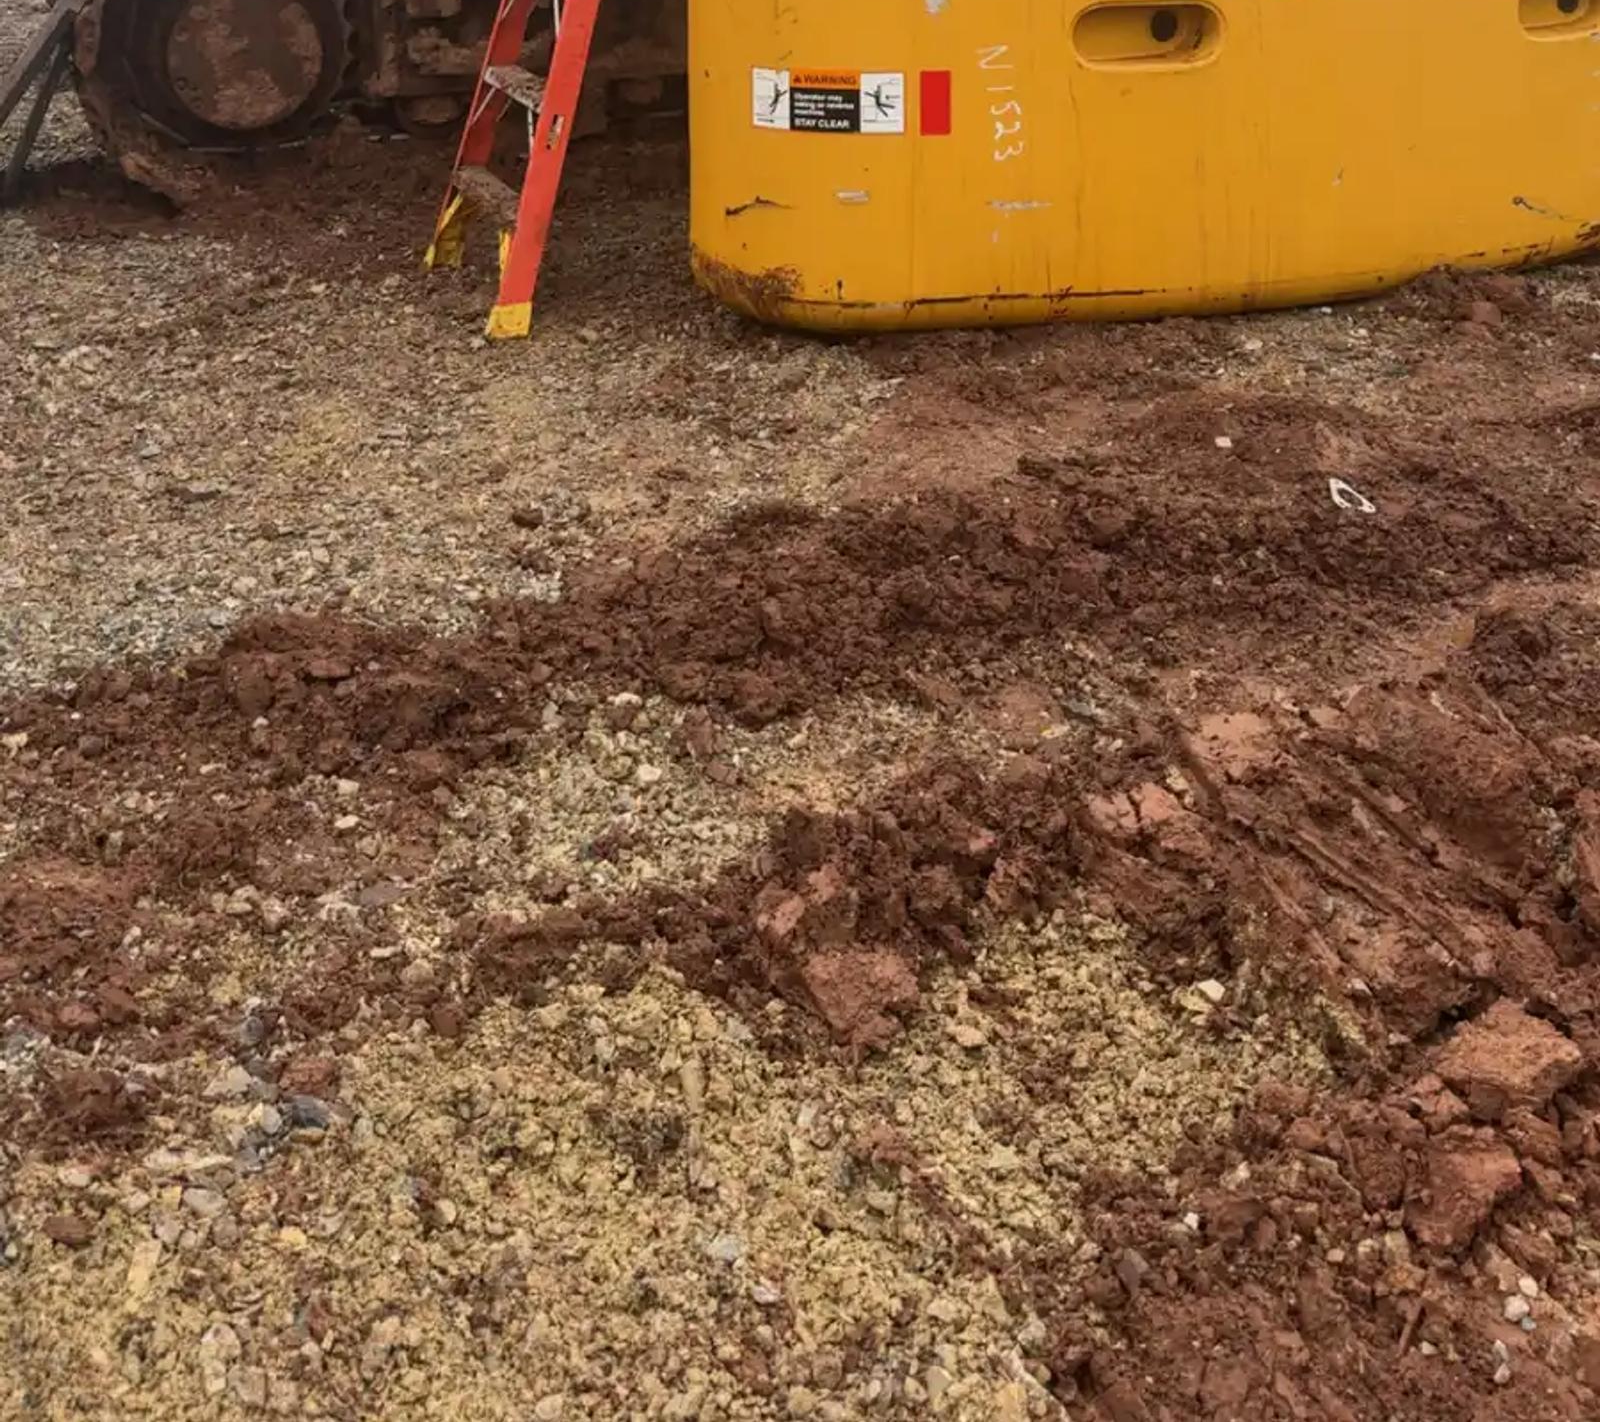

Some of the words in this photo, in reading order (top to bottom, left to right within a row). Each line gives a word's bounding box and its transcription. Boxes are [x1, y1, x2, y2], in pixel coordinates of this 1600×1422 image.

[803, 73, 857, 86] WARNING
[827, 94, 843, 103] may
[794, 118, 817, 127] STAY
[817, 119, 850, 129] CLEAR
